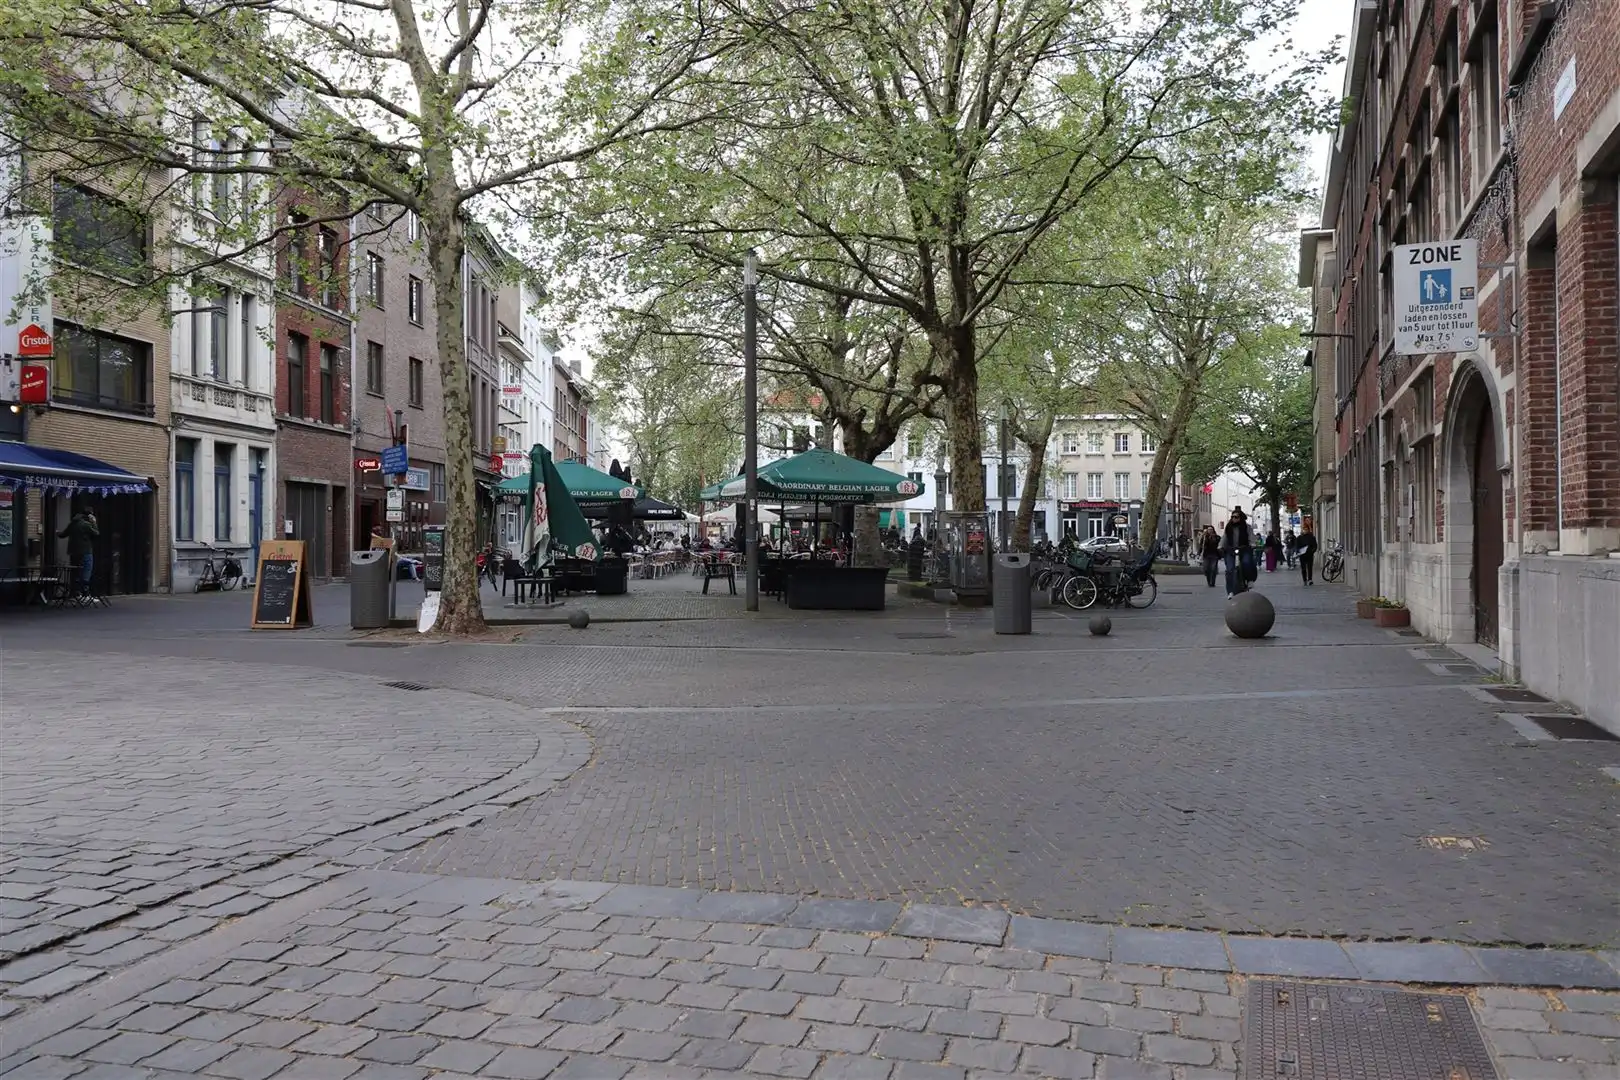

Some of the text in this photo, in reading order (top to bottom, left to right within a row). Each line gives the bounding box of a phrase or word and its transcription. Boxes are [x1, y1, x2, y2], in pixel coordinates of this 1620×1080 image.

[1409, 245, 1462, 264] ZONE
[1408, 302, 1464, 314] Uitgezonderd
[1404, 314, 1427, 322] laden
[1440, 312, 1468, 320] lossen
[1414, 323, 1420, 331] 5
[1452, 320, 1458, 329] 11
